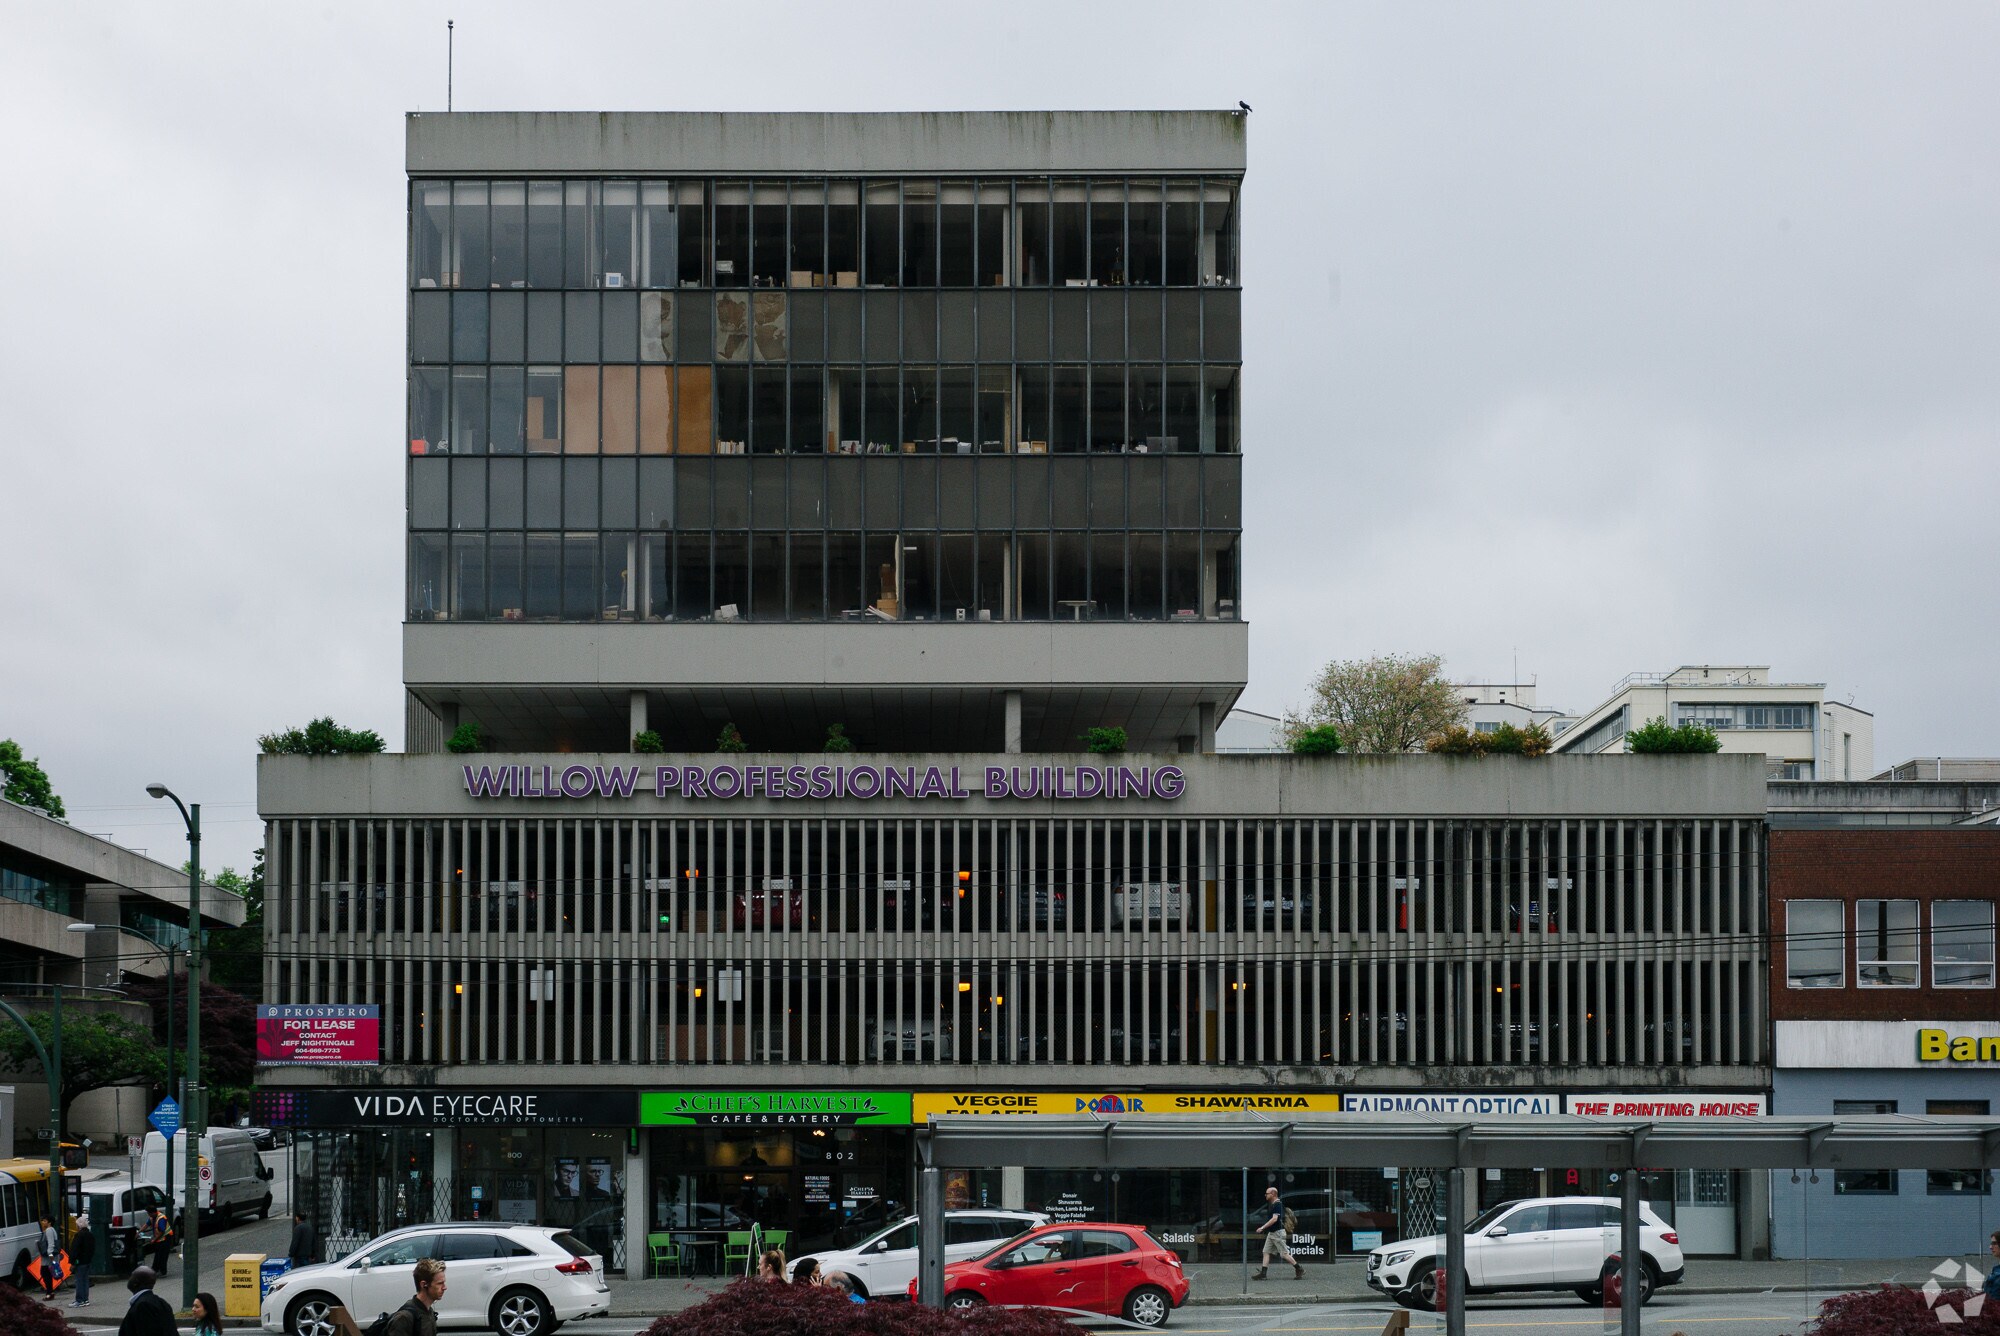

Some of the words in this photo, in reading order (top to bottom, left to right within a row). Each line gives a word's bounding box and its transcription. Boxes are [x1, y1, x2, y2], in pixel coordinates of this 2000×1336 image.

[462, 764, 640, 797] WILLOW
[655, 764, 969, 798] PROFESSIONAL
[984, 765, 1186, 799] BUILDING
[284, 1008, 368, 1017] PROSPERO
[283, 1021, 310, 1029] FOR
[314, 1021, 355, 1029] LEASE
[353, 1096, 425, 1116] VIDA
[433, 1095, 538, 1116] EYECARE
[691, 1095, 761, 1110] CHEF'S
[768, 1095, 862, 1110] HARVEST
[953, 1096, 1037, 1106] VEGGIE
[1076, 1097, 1145, 1112] DONAIR
[1175, 1096, 1310, 1107] SHAWARMA
[1575, 1103, 1609, 1116] THE
[1612, 1103, 1694, 1116] PRINTING
[1698, 1103, 1760, 1116] HOUSE
[711, 1113, 752, 1123] CAFÉ
[761, 1115, 768, 1123] &
[777, 1115, 841, 1123] EATERY
[825, 1152, 854, 1160] 802
[1162, 1232, 1195, 1243] Salads
[1292, 1233, 1316, 1246] Daily
